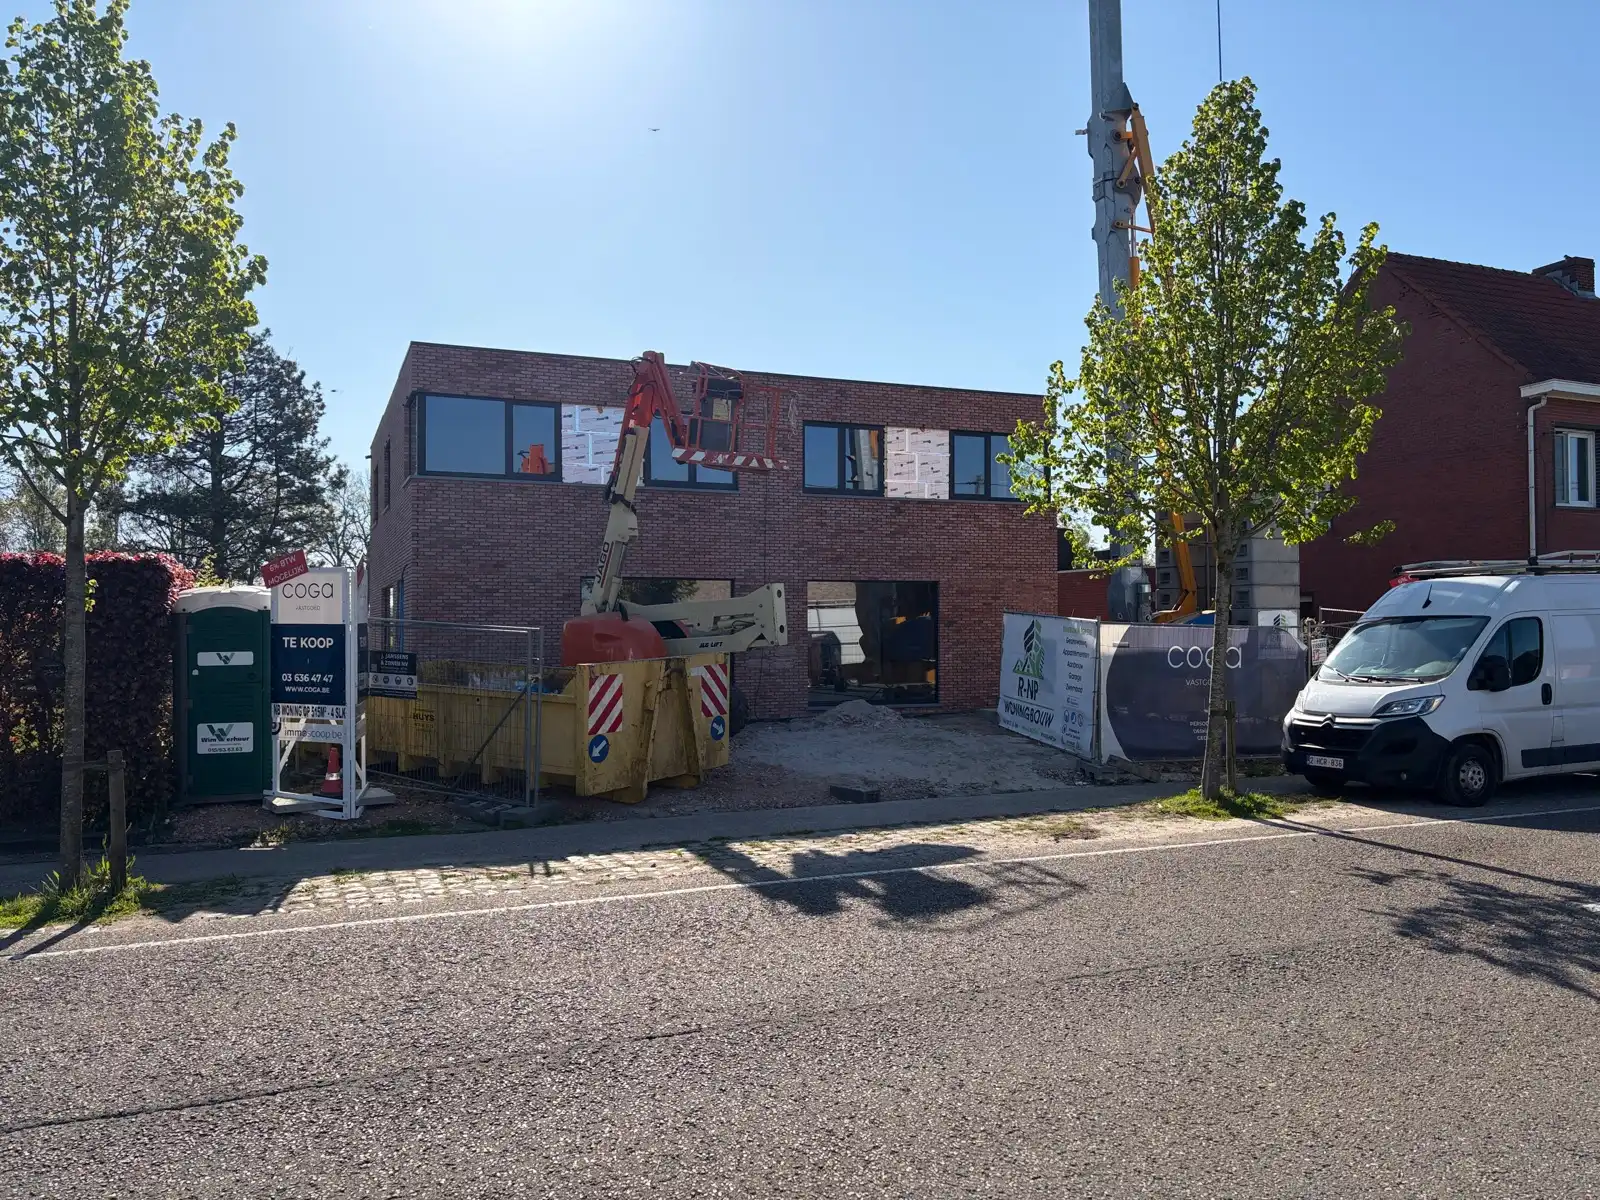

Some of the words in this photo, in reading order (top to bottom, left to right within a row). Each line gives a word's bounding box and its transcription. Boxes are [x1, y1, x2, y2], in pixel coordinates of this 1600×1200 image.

[269, 563, 280, 572] 6%
[280, 554, 296, 567] BTW
[596, 542, 610, 584] JAGO
[267, 564, 305, 585] MOGELIJK!
[282, 637, 297, 648] TE
[300, 637, 334, 649] KOOP
[281, 673, 292, 682] 03
[294, 673, 310, 682] 636
[311, 674, 321, 683] 47
[323, 674, 334, 683] 47
[285, 686, 331, 694] WWW.COGA.BE
[1017, 677, 1039, 700] R-NP
[335, 707, 347, 719] SLK
[413, 713, 435, 722] HUYS
[1004, 699, 1055, 728] WONINGBOUW
